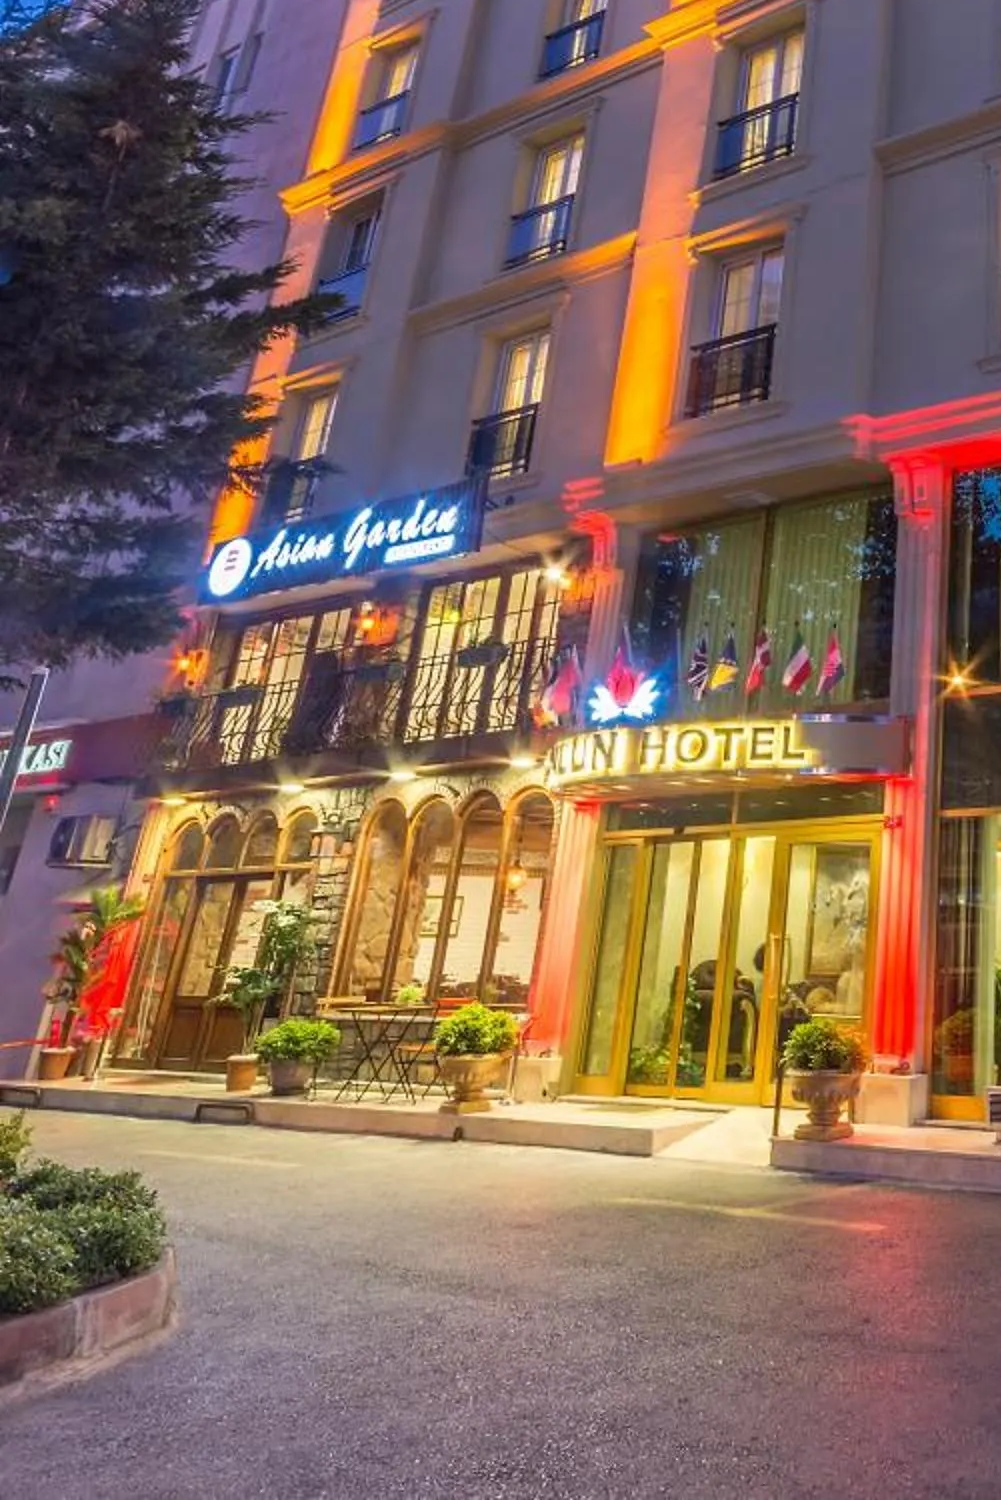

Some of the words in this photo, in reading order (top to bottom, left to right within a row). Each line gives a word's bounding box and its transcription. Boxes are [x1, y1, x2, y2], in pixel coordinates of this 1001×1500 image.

[249, 528, 334, 579] Asian
[343, 498, 459, 570] Garden
[639, 724, 806, 765] HOTEL
